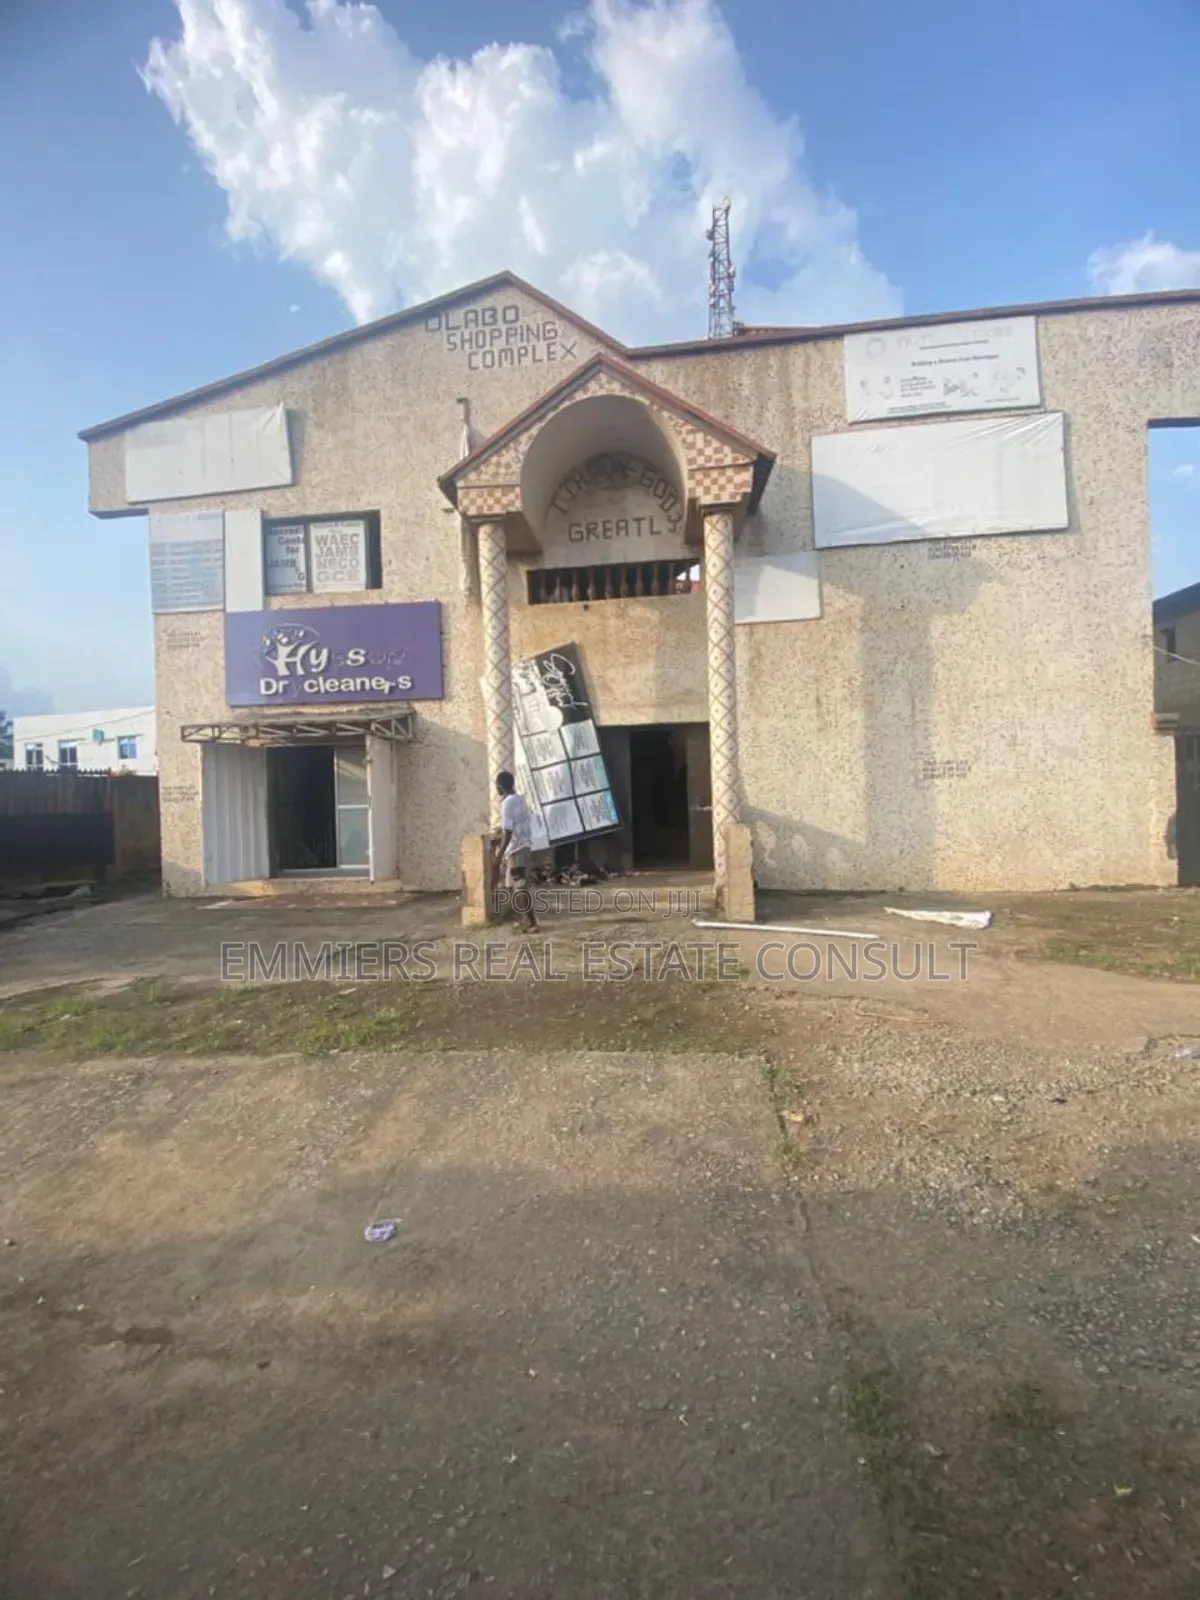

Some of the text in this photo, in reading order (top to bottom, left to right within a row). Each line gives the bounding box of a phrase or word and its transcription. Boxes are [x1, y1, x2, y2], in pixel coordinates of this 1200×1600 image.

[425, 304, 520, 332] OLABO
[446, 321, 558, 351] SHOPPING
[467, 341, 577, 370] COMPLEX
[639, 468, 681, 512] GOD
[315, 532, 360, 547] WAEC
[316, 558, 359, 571] NECO
[316, 571, 360, 583] GCE
[303, 674, 412, 695] cleaners
